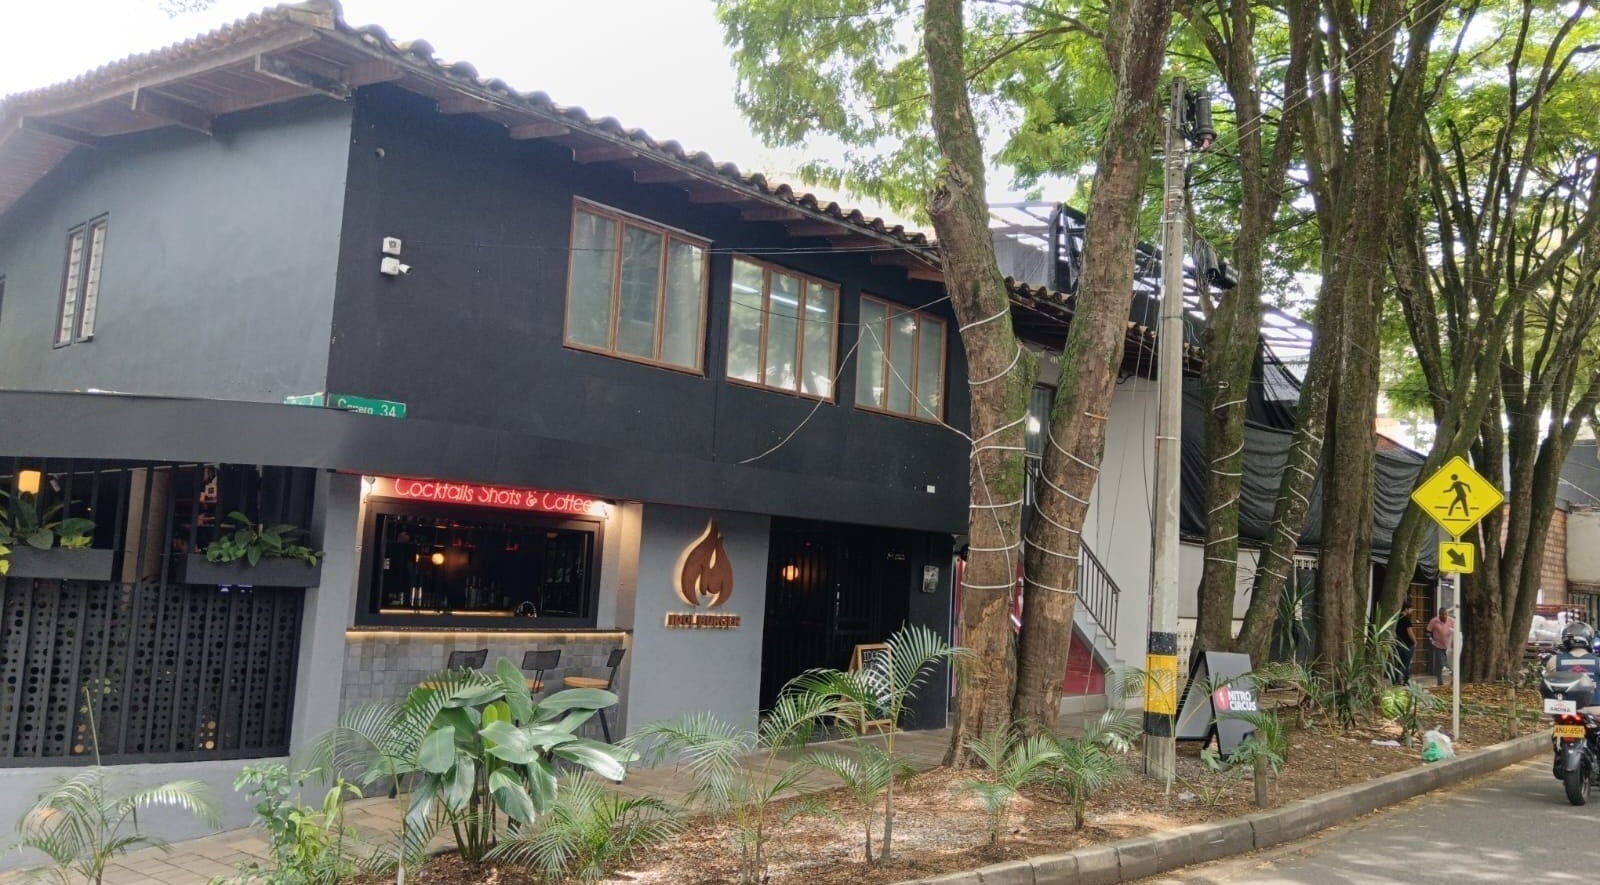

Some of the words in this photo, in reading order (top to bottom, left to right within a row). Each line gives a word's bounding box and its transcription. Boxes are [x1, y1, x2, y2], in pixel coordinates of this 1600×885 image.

[395, 478, 474, 502] Cocktails
[478, 486, 522, 507] Shots
[526, 490, 538, 508] &
[697, 614, 741, 628] BURGER
[1229, 690, 1252, 701] NITRO
[1230, 700, 1257, 711] CIRCUS
